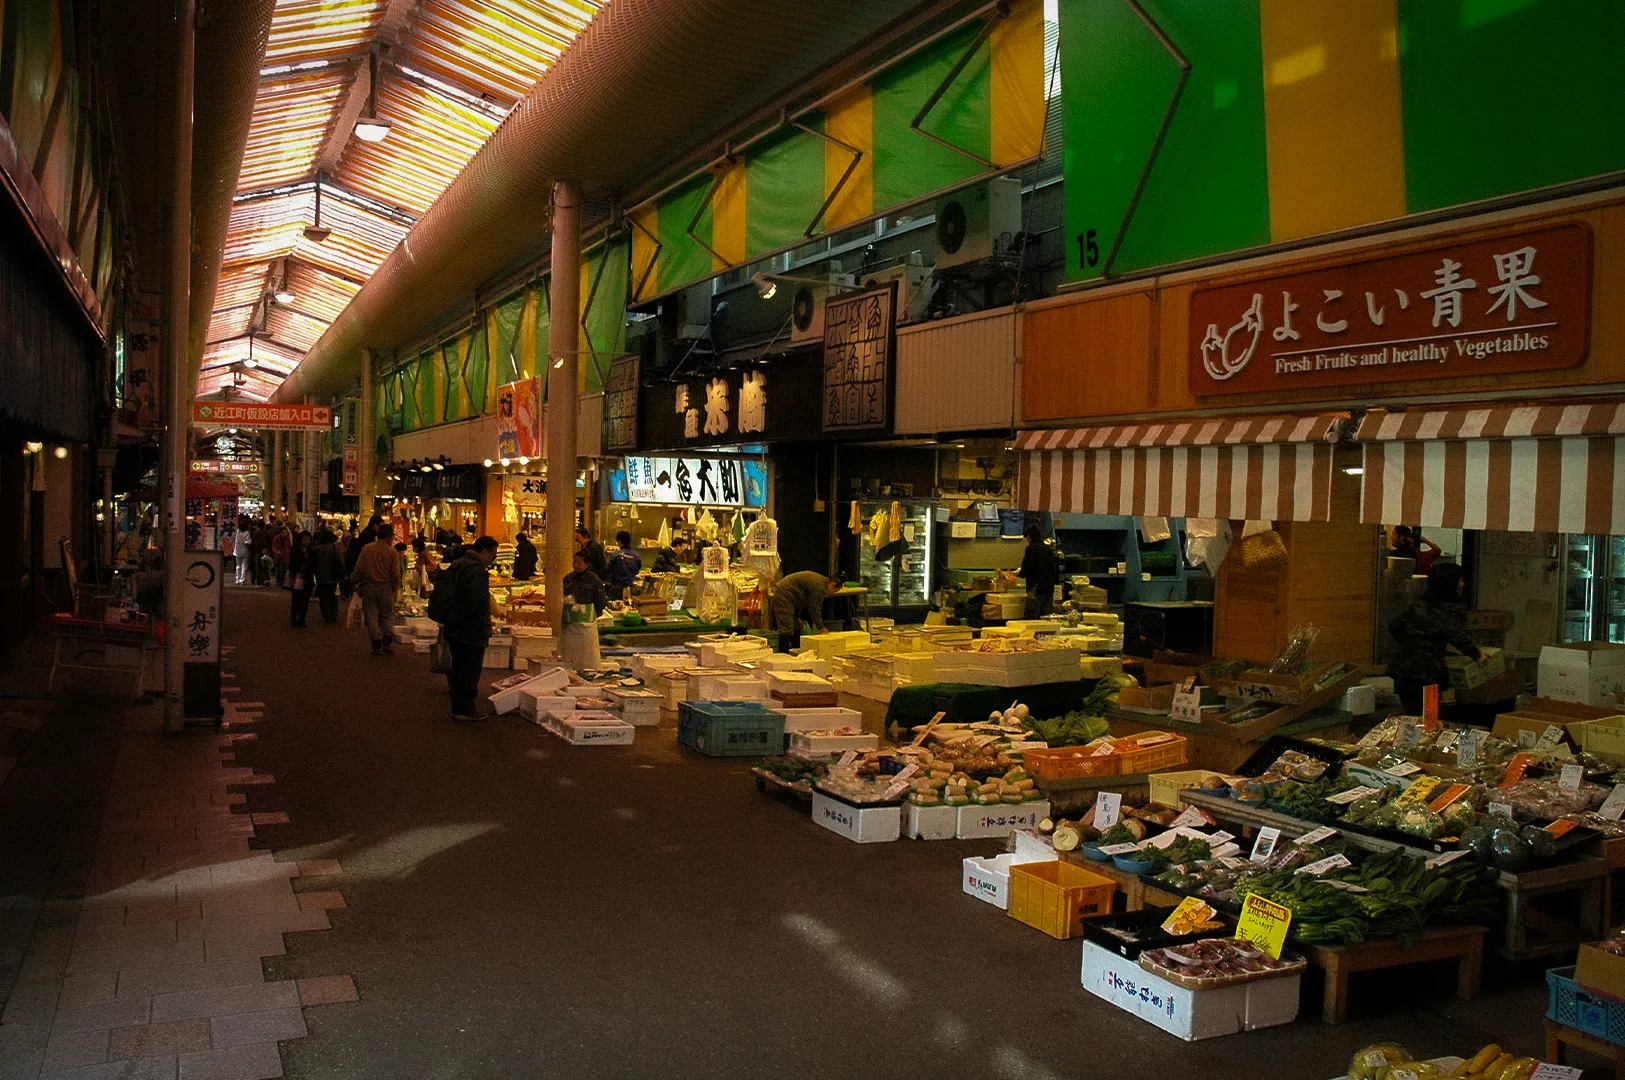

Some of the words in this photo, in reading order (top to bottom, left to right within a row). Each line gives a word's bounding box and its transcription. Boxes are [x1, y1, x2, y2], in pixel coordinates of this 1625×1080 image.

[1076, 229, 1099, 269] 15
[1272, 246, 1548, 341] よこい青果
[1275, 354, 1312, 374] Fresh
[1315, 350, 1357, 370] Fruits
[1359, 347, 1387, 366] and
[1392, 343, 1449, 363] healthy
[1454, 333, 1549, 360] Vegetables
[213, 406, 310, 421] 近江町仮設店舗入口
